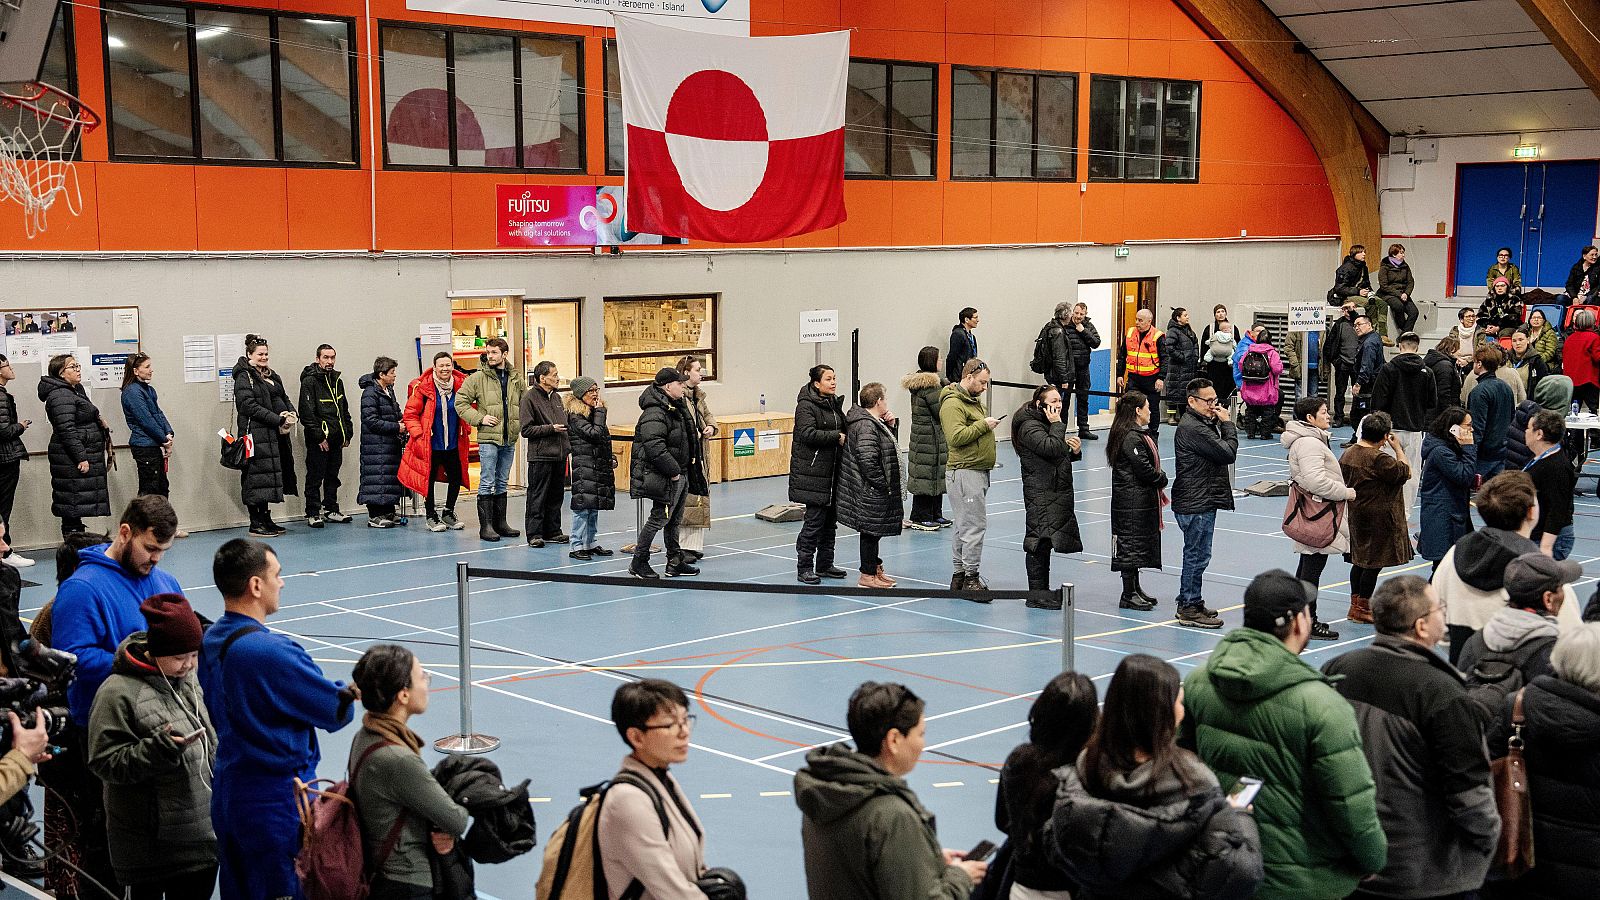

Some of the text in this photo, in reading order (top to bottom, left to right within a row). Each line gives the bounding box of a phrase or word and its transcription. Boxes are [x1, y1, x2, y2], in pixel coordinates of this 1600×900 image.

[662, 1, 685, 12] Island
[508, 191, 550, 217] FUJITSU
[508, 220, 533, 229] Shaping
